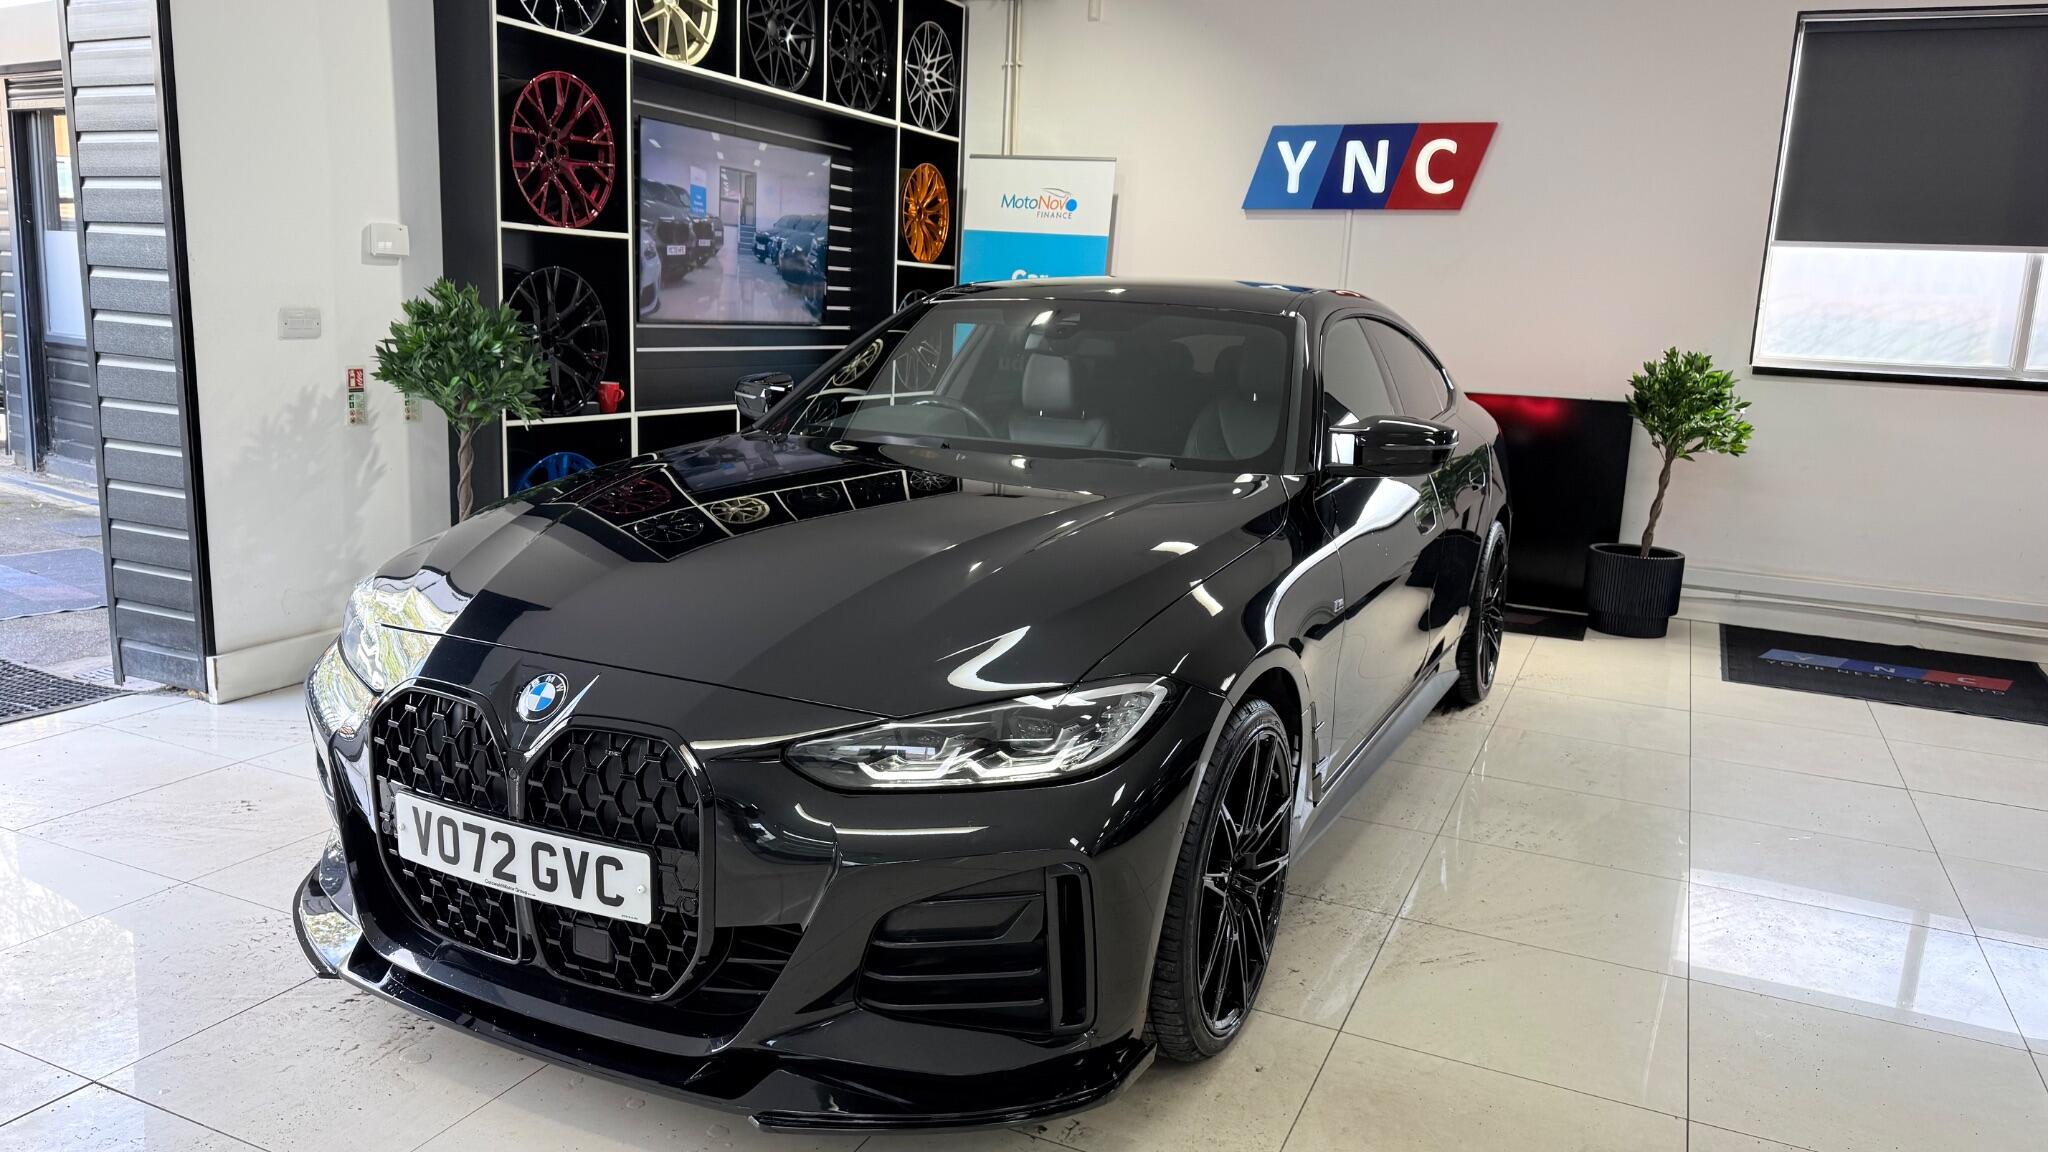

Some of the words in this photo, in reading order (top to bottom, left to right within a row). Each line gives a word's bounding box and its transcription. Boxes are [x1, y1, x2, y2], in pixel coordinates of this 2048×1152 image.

[1277, 138, 1458, 195] YNC
[1000, 193, 1078, 212] MotoNovo
[1036, 211, 1072, 220] FINANCE
[531, 675, 565, 692] BMW
[1767, 659, 1824, 671] YOUR
[1906, 678, 1951, 688] CAR
[1963, 686, 2006, 696] LTD
[412, 806, 517, 883] VO72
[531, 841, 625, 907] GVC
